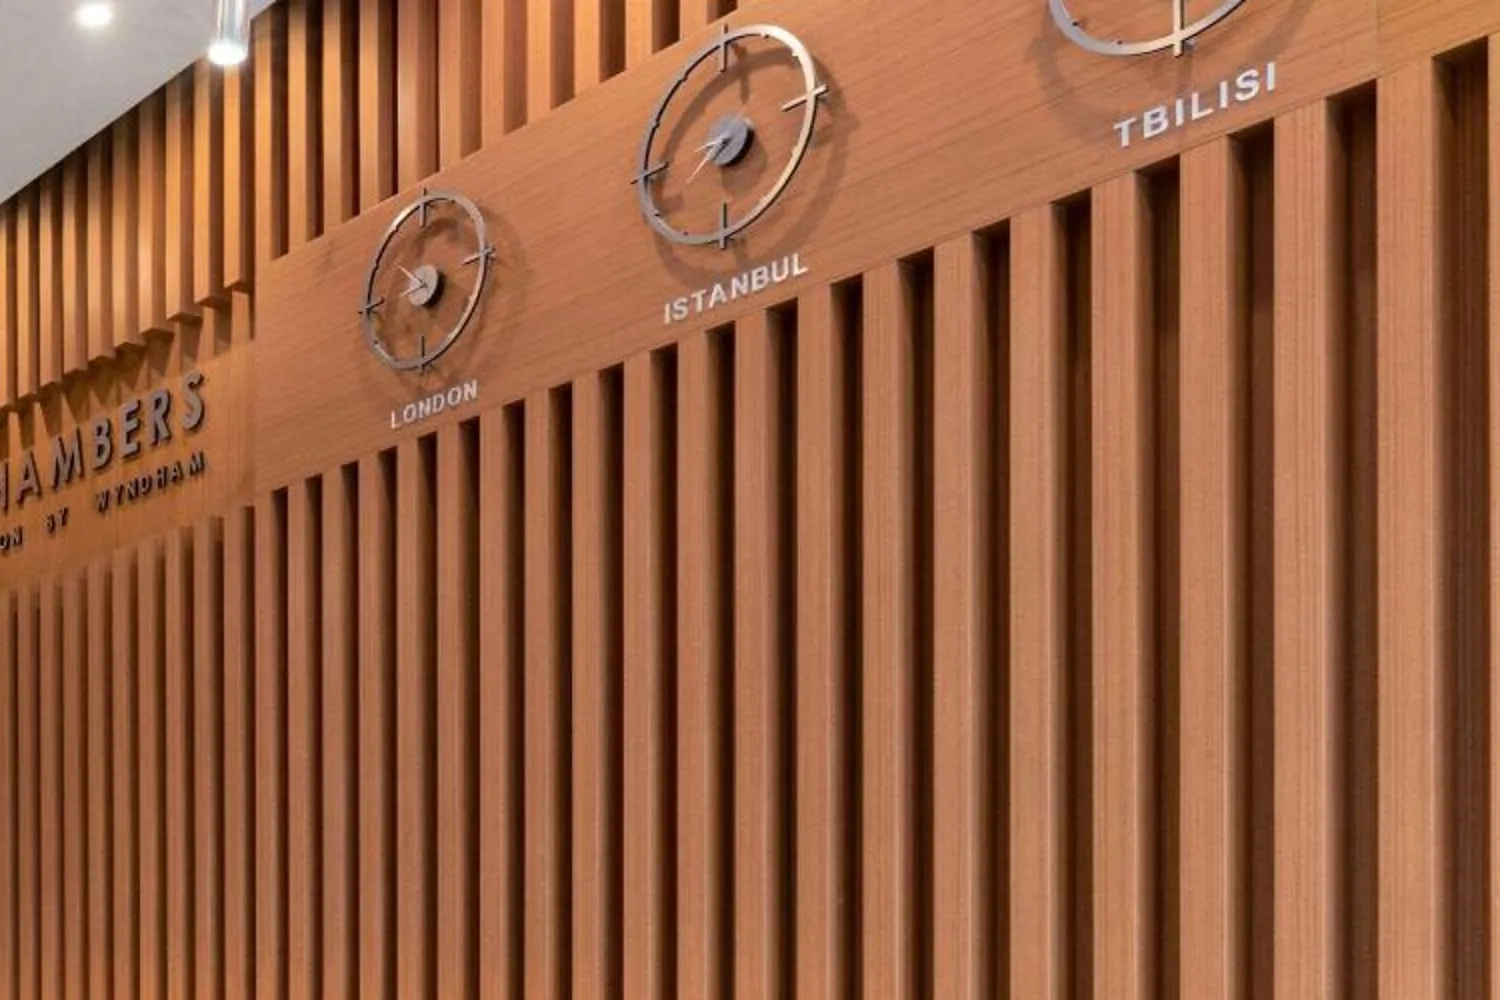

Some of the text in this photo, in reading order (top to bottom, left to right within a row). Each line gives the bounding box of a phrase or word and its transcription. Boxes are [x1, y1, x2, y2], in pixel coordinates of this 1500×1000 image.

[1113, 61, 1276, 148] TBILISI
[663, 253, 809, 325] ISTANBUL
[389, 378, 479, 429] LONDON
[47, 506, 70, 535] BY
[96, 451, 207, 513] WYNDHAM
